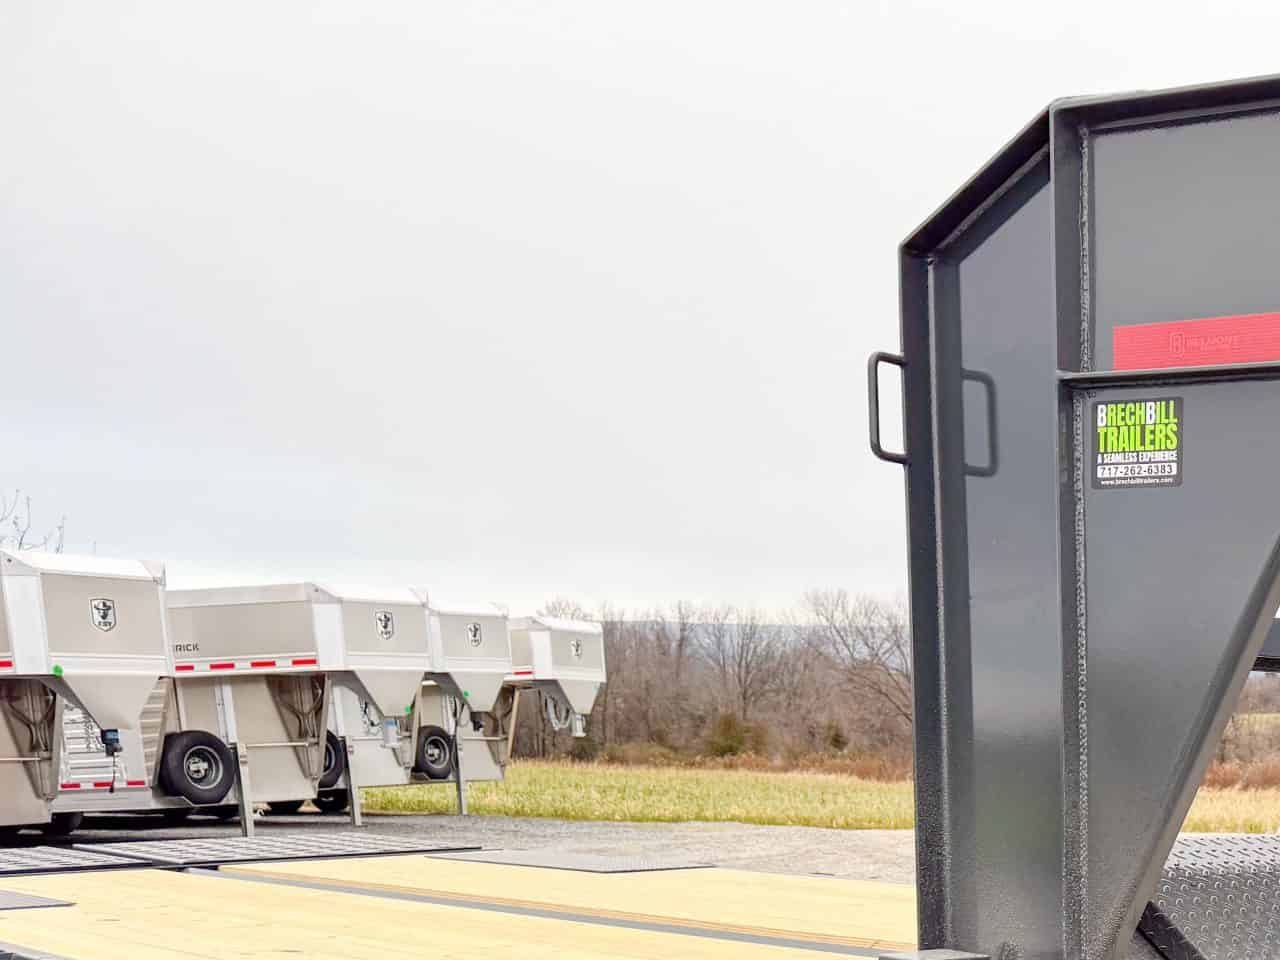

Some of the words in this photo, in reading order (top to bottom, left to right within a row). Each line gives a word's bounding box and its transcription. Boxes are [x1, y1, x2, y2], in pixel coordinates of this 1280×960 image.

[1097, 400, 1178, 427] BRECHBILL
[1097, 423, 1178, 453] TRAILERS
[1097, 453, 1103, 464] A
[1103, 452, 1138, 464] SEAMLESS
[1139, 450, 1178, 461] EXPERIENCE
[1100, 464, 1173, 476] 717-262-6383
